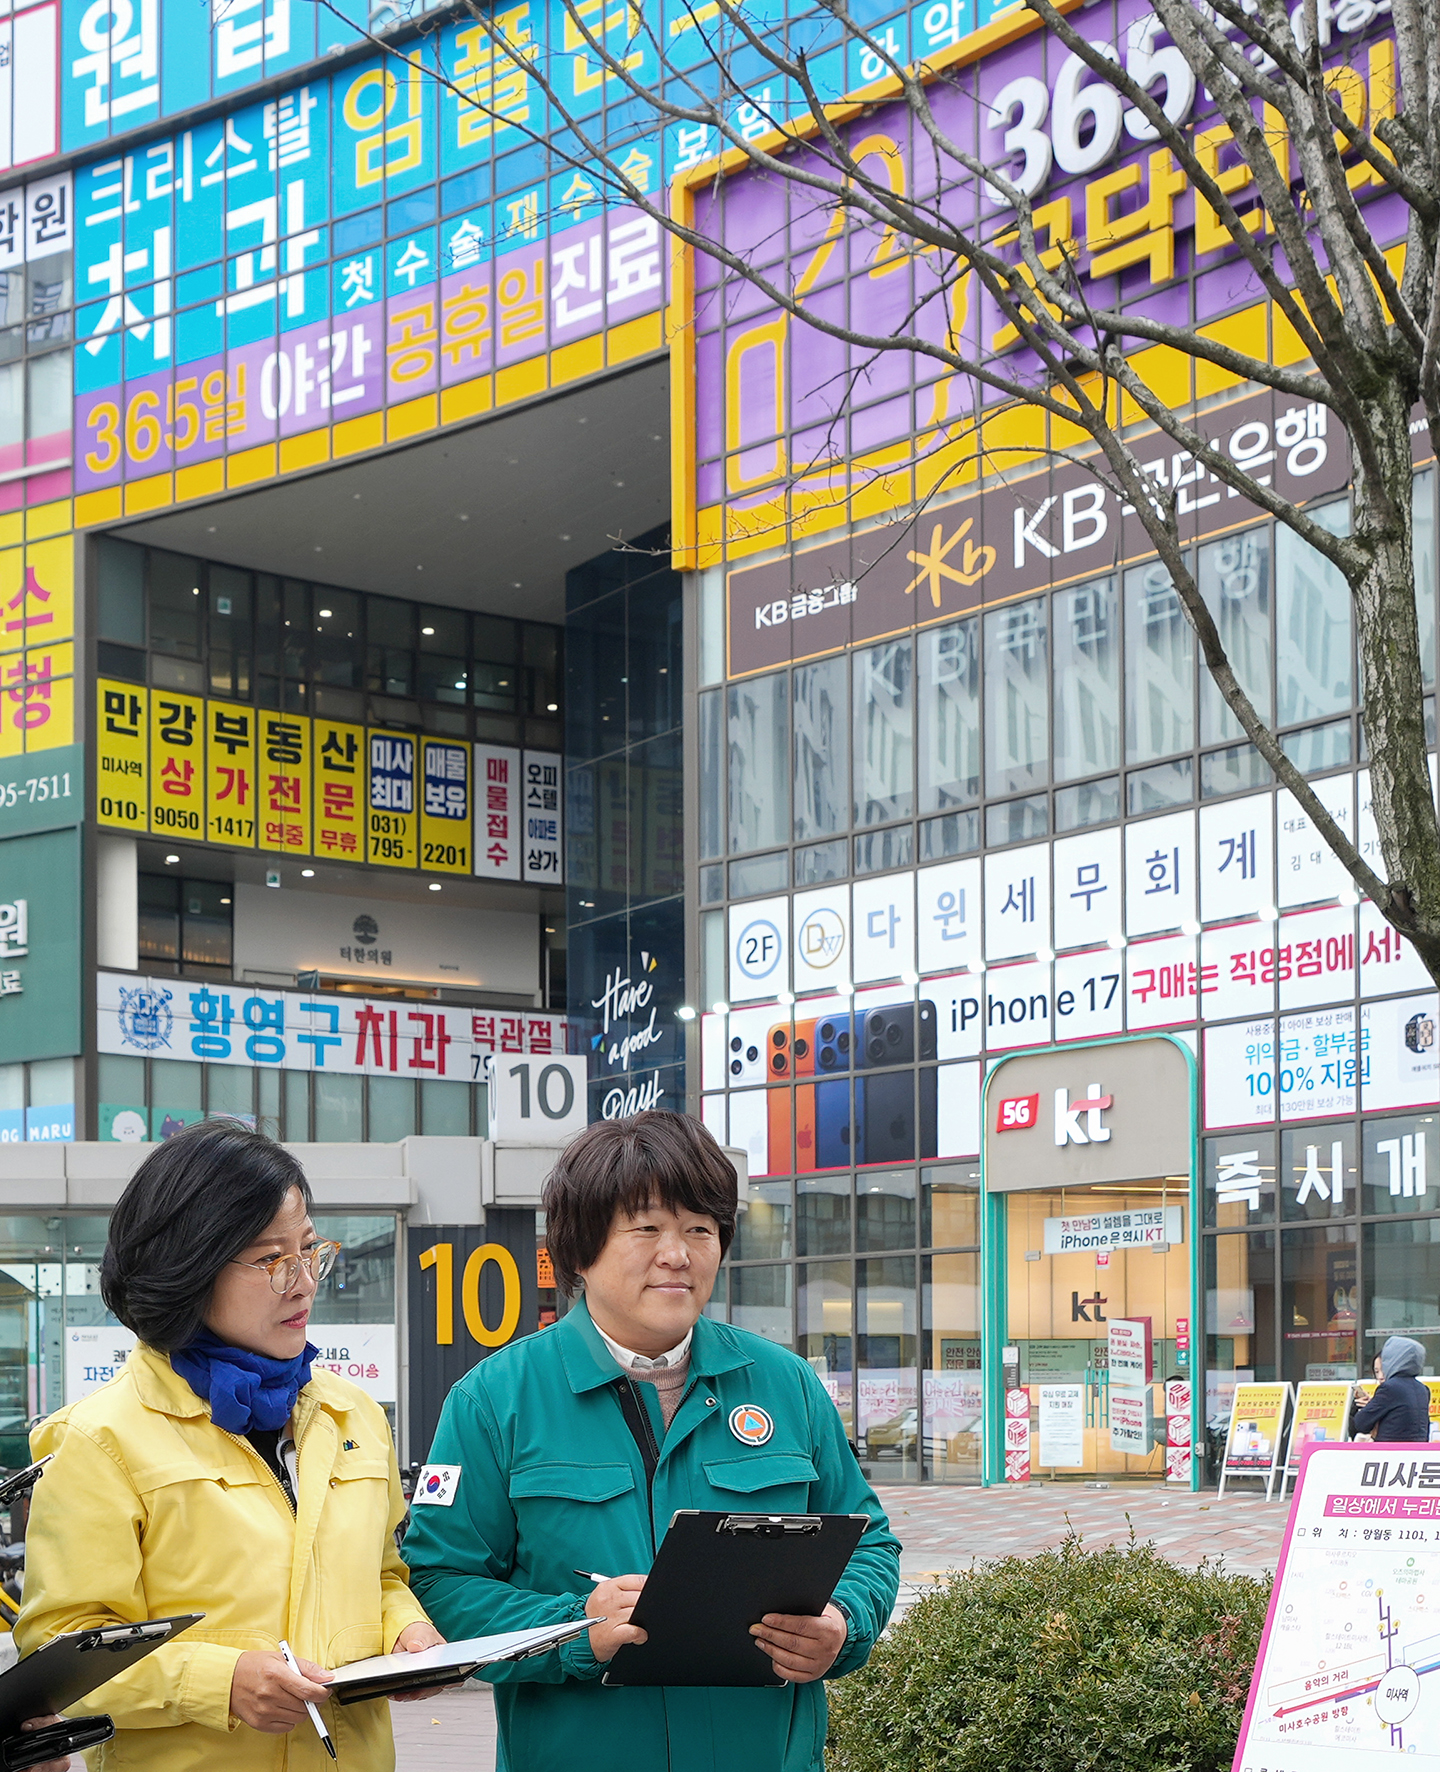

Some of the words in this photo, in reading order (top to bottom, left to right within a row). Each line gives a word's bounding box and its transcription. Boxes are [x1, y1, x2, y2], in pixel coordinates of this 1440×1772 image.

[984, 11, 1195, 206] 365
[85, 86, 318, 226] 크리스탈
[84, 179, 319, 359] 치과
[84, 363, 248, 475] 365일
[260, 323, 372, 422] 야간
[386, 259, 546, 386] 공휴일
[551, 212, 661, 329] 진료
[1013, 483, 1108, 568] KB
[104, 686, 358, 775] 만강부동산
[371, 740, 414, 772] 미사
[425, 746, 466, 781] 매물
[101, 756, 143, 778] 미사역
[160, 755, 356, 820] 상가전문
[371, 775, 414, 811] 최대
[425, 781, 466, 816] 보유
[153, 806, 200, 831] 9050
[370, 813, 407, 836] 031)
[486, 758, 509, 868] 매물접수
[527, 819, 557, 842] 아파트
[265, 822, 304, 847] 연중
[320, 830, 357, 855] 무휴
[423, 842, 467, 866] 2201
[527, 849, 558, 872] 상가
[339, 946, 392, 966] 터한의원
[592, 967, 653, 1034] Have
[950, 985, 1075, 1034] iPhone
[1085, 974, 1120, 1012] 17
[1131, 960, 1219, 1005] 구매는
[188, 987, 342, 1068] 황영구
[355, 1002, 451, 1076] 치과
[470, 1014, 552, 1054] 턱관절
[509, 1063, 574, 1119] 10
[1246, 1066, 1314, 1097] 100%
[1321, 1055, 1371, 1089] 지원
[30, 1121, 72, 1141] MARU
[1003, 1100, 1031, 1125] 5G
[1055, 1083, 1113, 1146] kt
[1062, 1221, 1070, 1232] 첫
[1073, 1218, 1100, 1232] 만남의
[1134, 1212, 1163, 1226] 그대로
[1123, 1230, 1143, 1242] 역시
[1146, 1228, 1163, 1241] KT
[419, 1242, 521, 1347] 10
[1072, 1291, 1108, 1322] kt
[348, 1364, 379, 1378] 이용
[1331, 1497, 1397, 1516] 일상에서
[1362, 1529, 1392, 1541] 망월동
[1386, 1687, 1408, 1702] 미사역
[1279, 1711, 1329, 1734] 미사호수공원
[1331, 1705, 1349, 1721] 방향
